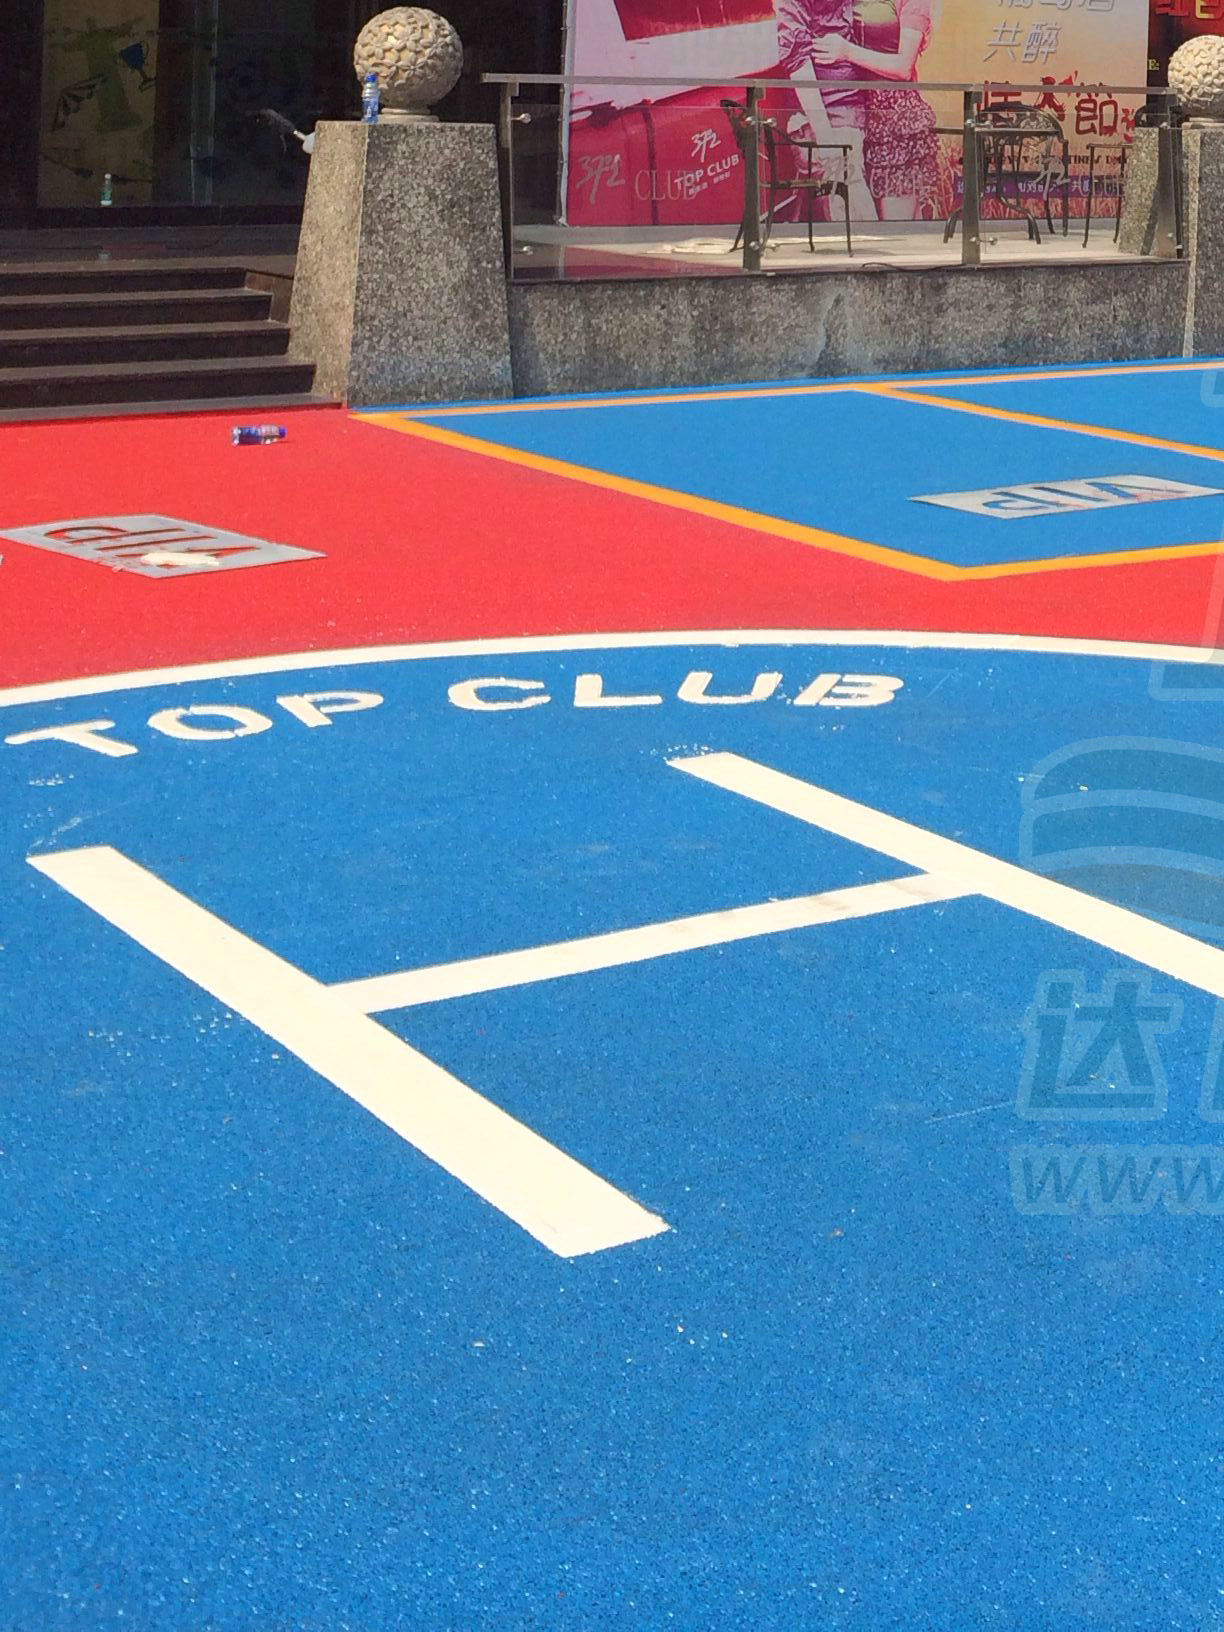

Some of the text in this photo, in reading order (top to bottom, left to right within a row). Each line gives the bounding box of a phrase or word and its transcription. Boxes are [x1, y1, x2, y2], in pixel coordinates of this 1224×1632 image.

[984, 19, 1063, 64] 共醉
[673, 169, 704, 190] TOP
[706, 154, 740, 177] CLUB
[4, 669, 906, 758] TOP CLUB
